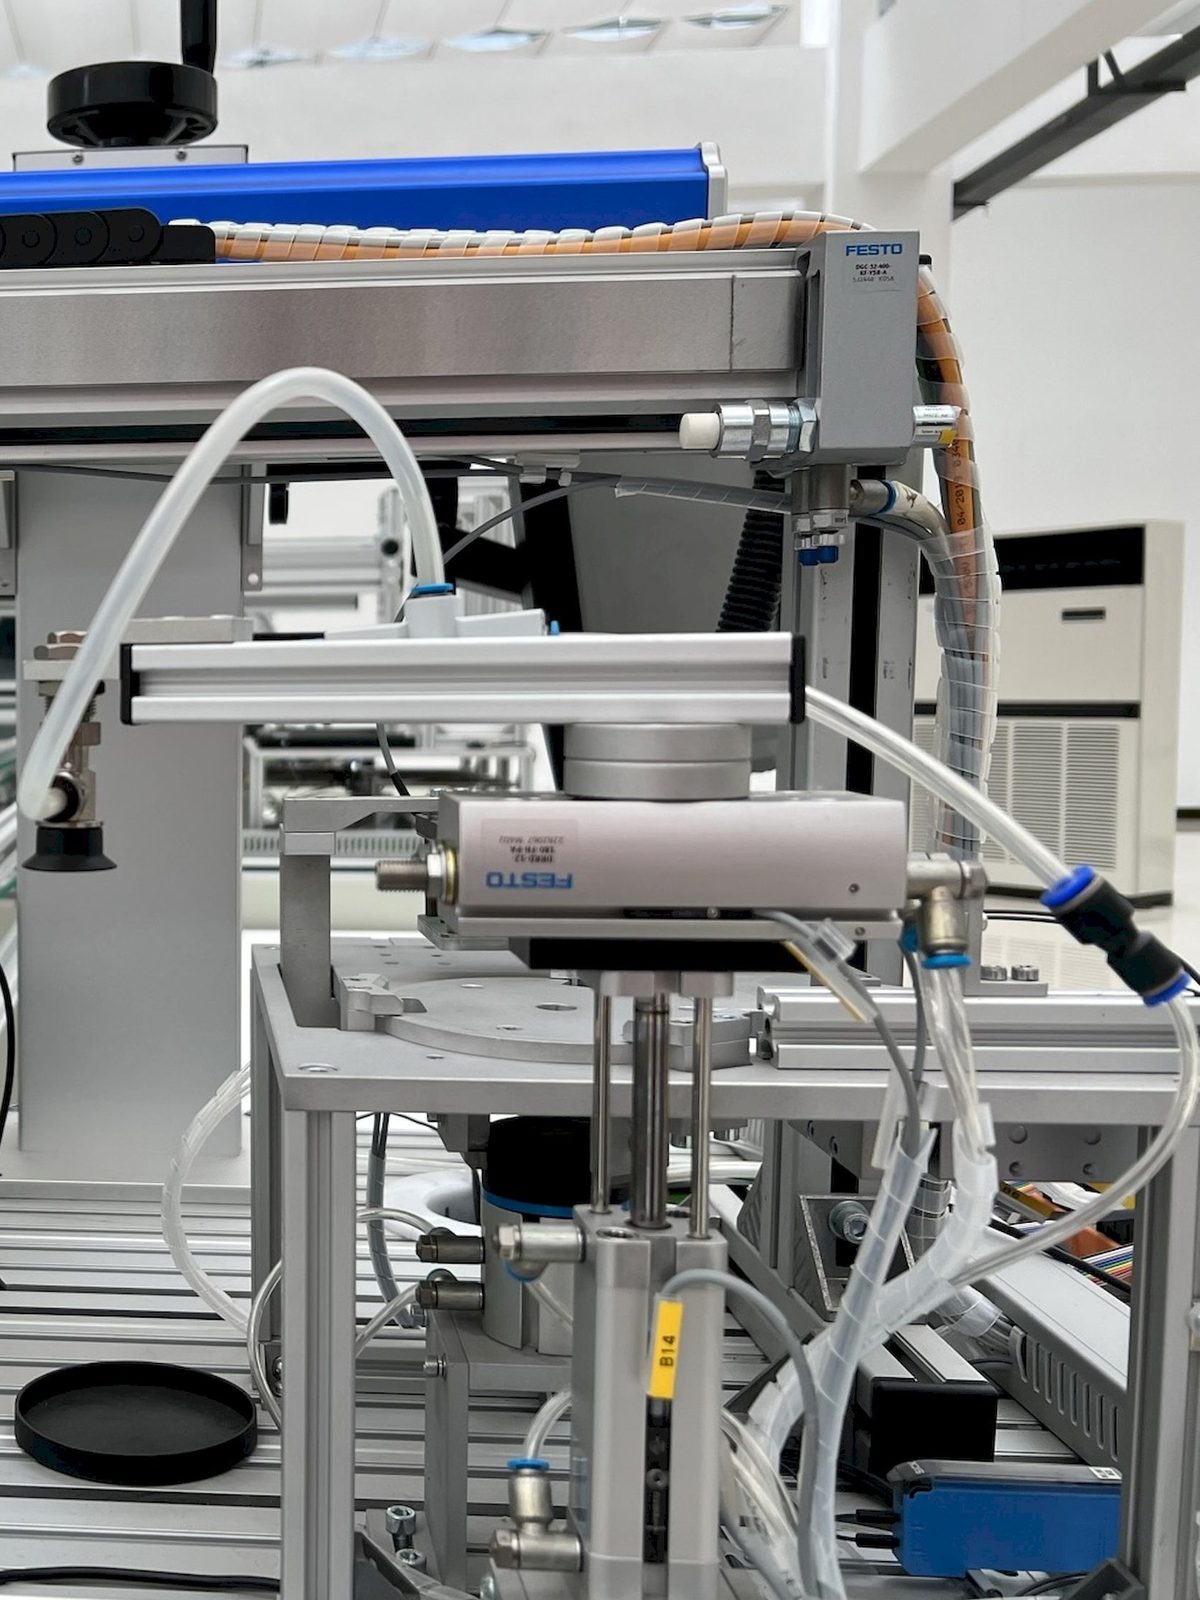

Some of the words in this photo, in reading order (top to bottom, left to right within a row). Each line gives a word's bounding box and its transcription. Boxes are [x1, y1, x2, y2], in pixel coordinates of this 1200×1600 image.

[845, 243, 903, 257] FESTO
[485, 872, 573, 889] FESTO
[660, 1334, 676, 1368] B14
